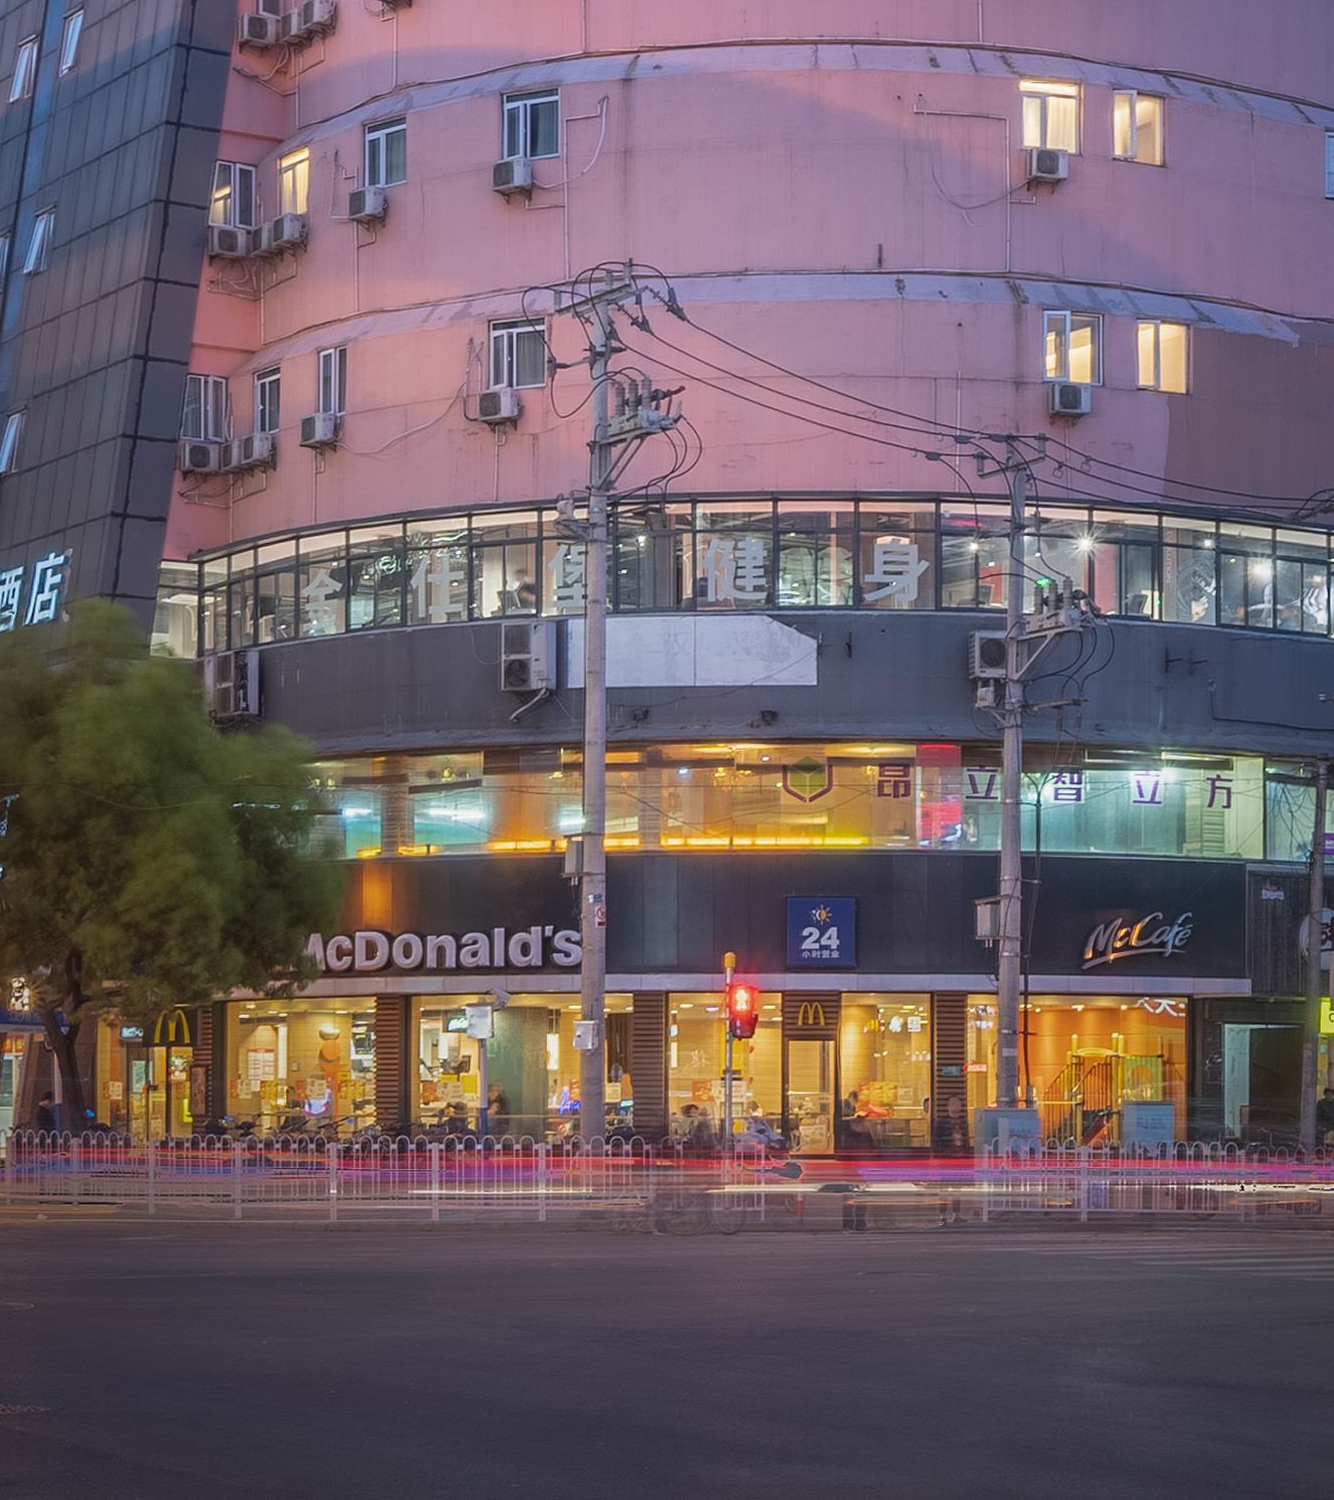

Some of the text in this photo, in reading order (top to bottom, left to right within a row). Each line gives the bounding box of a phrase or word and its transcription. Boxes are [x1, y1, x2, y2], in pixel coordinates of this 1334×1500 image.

[877, 763, 1233, 809] 昂立智立方
[801, 926, 840, 950] 24
[801, 950, 841, 959] 小时营业
[1083, 912, 1193, 963] McCafé
